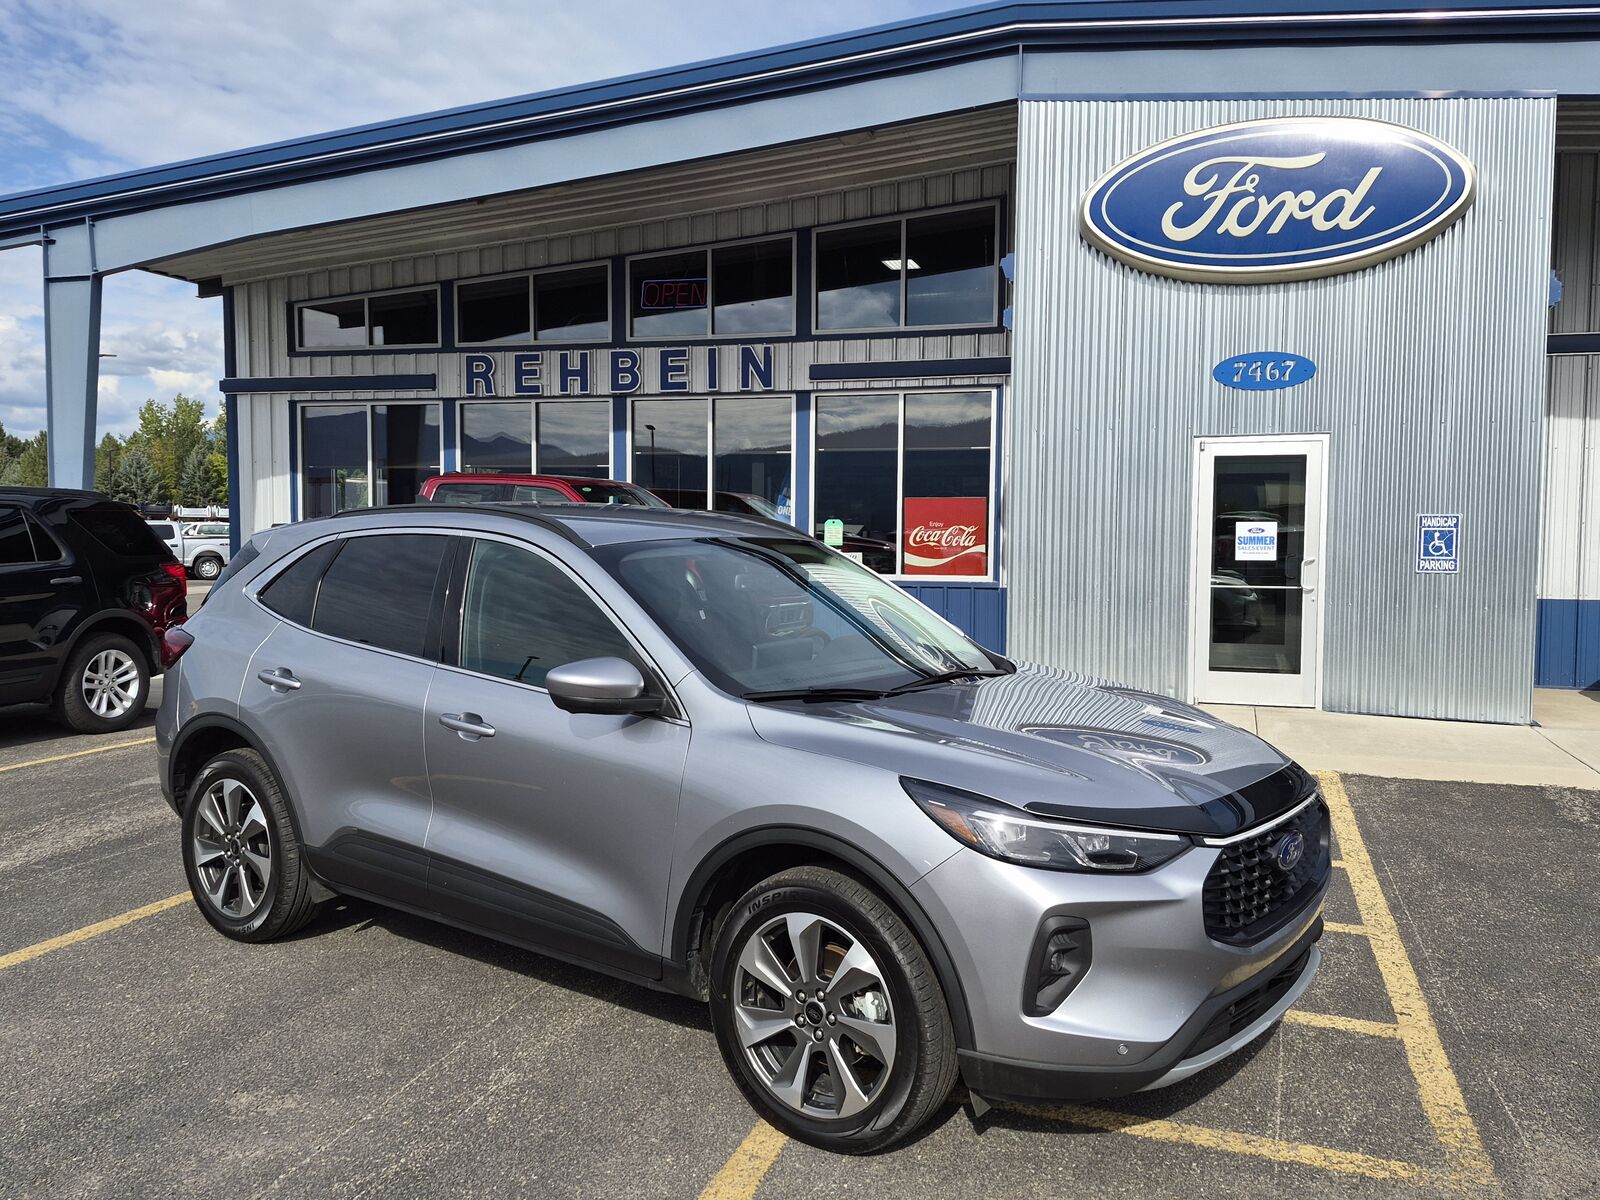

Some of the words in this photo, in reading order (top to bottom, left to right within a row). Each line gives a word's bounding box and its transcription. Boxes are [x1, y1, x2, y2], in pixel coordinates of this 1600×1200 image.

[1161, 152, 1383, 242] Ford
[644, 283, 707, 306] OPEN
[465, 345, 774, 396] REHBEIN
[1232, 360, 1297, 382] 7467
[1422, 517, 1457, 527] HANDICAP
[909, 525, 979, 547] Coca-Cola
[1237, 536, 1275, 545] SUMMER
[1420, 560, 1455, 570] PARKING
